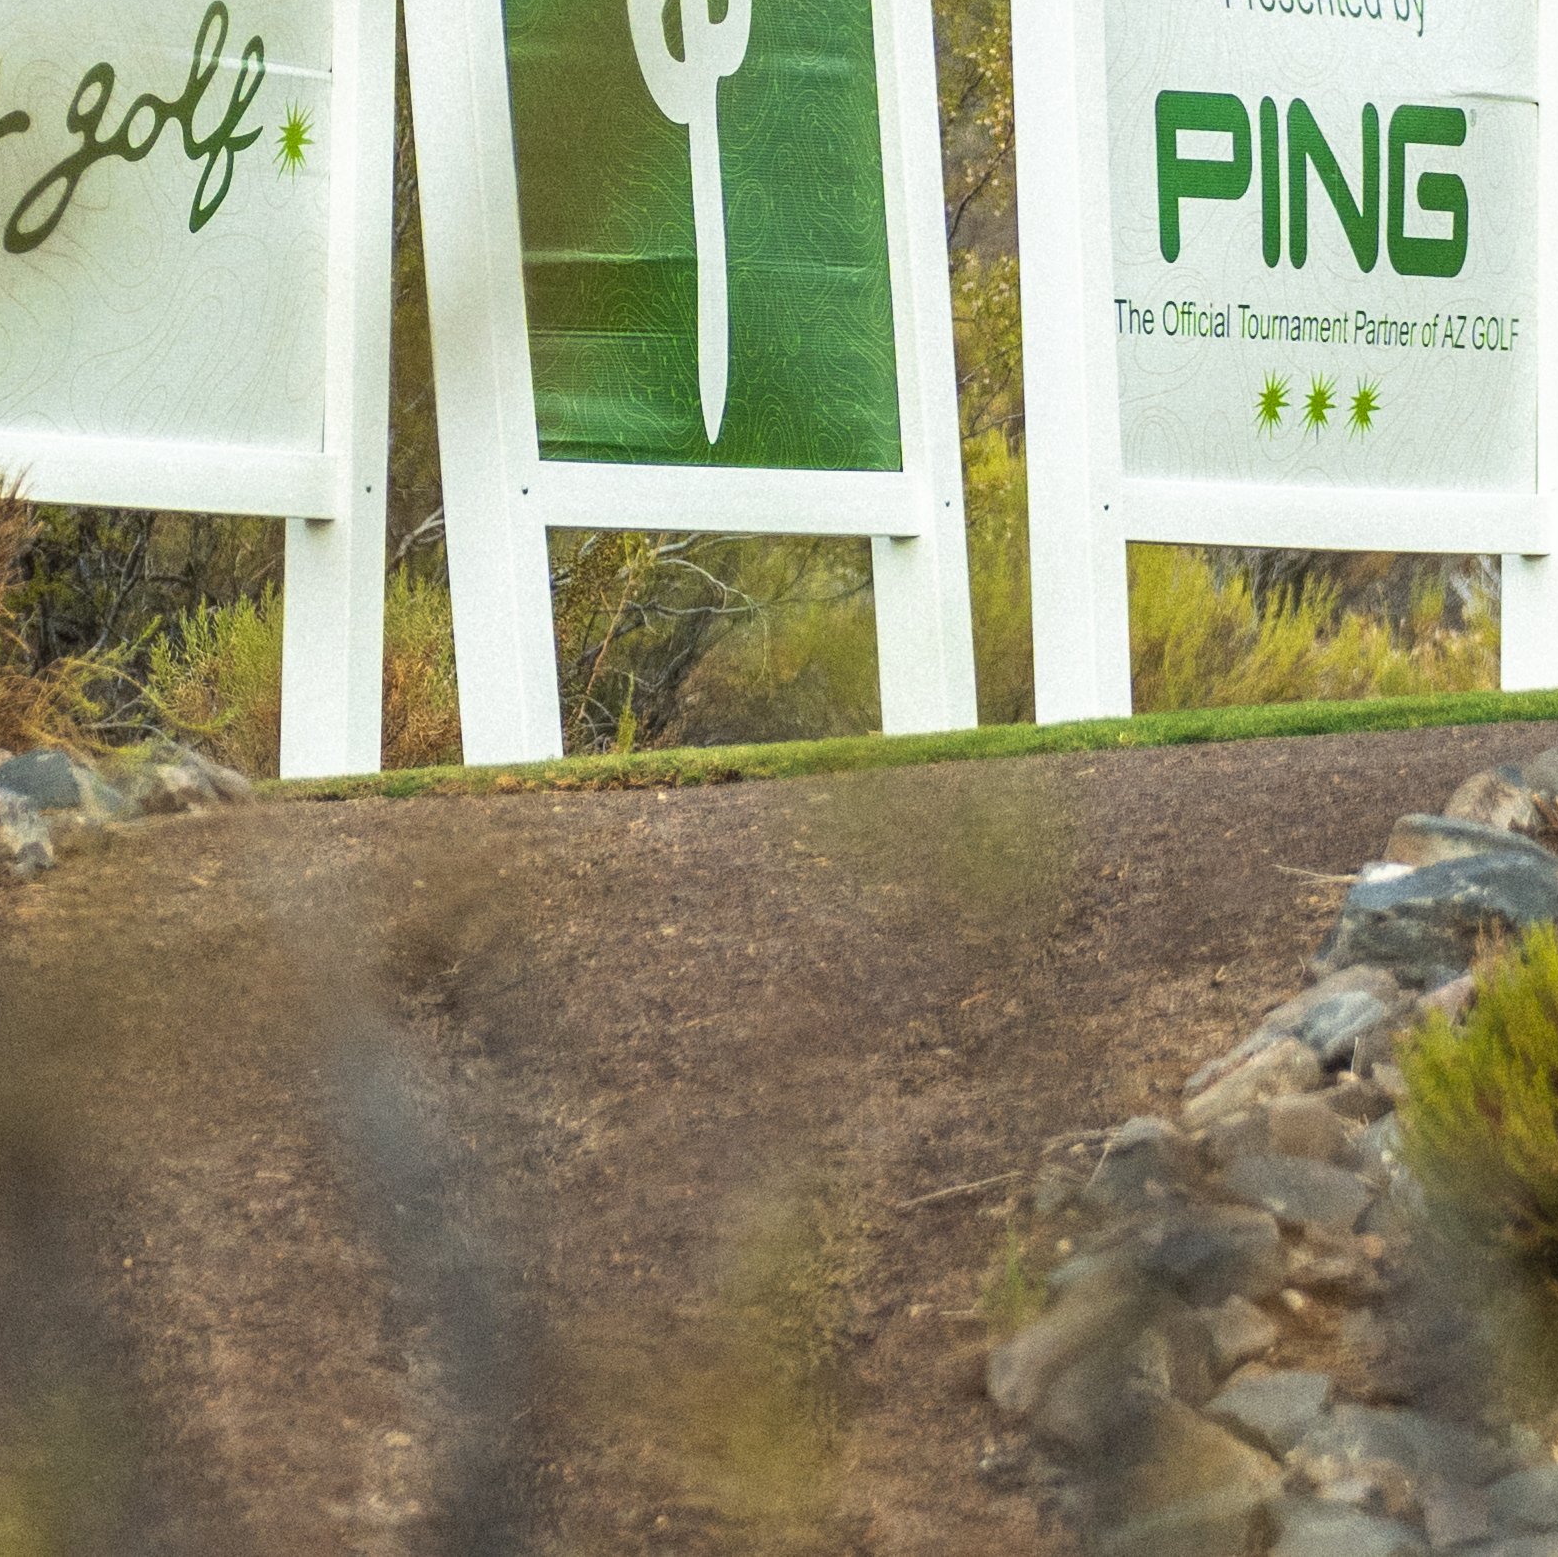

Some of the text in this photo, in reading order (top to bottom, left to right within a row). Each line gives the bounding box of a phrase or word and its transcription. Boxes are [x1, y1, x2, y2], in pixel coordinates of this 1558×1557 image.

[3, 0, 264, 254] golf
[1154, 89, 1469, 278] PING
[1113, 298, 1520, 352] The Official Tournament Partner of AZ GOLF
